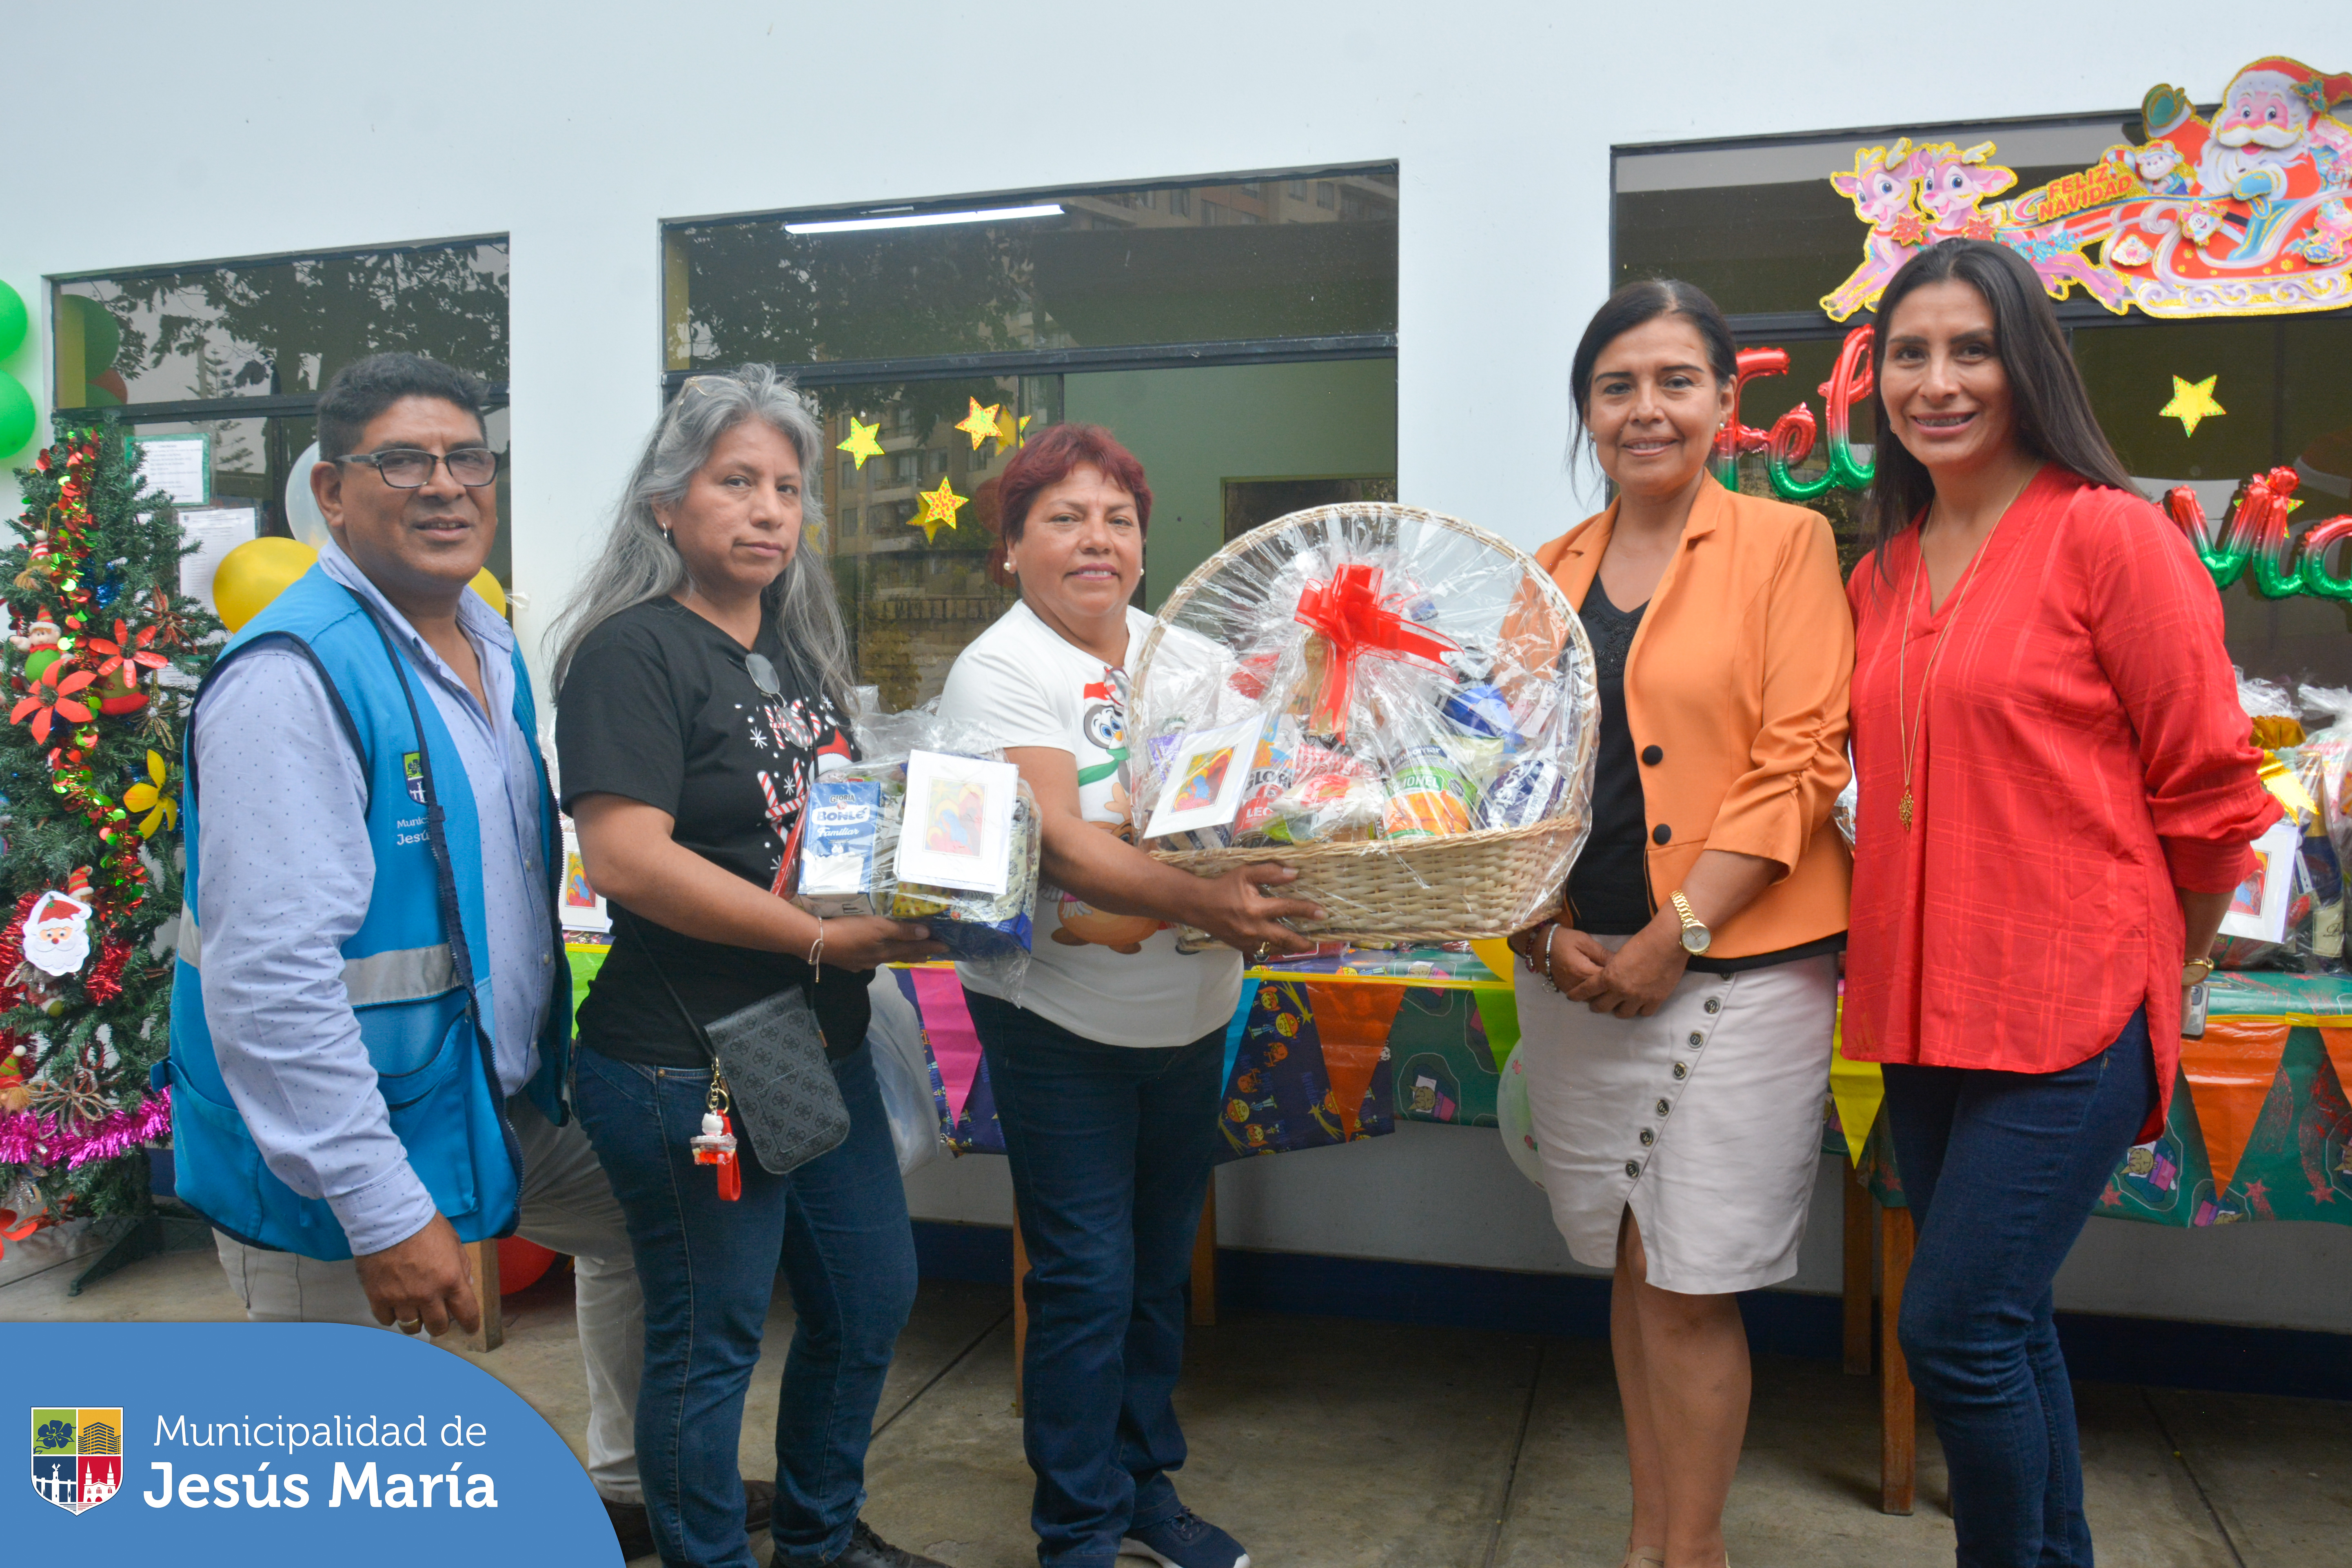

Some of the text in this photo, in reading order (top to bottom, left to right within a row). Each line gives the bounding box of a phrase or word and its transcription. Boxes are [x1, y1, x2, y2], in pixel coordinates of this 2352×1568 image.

[2049, 166, 2109, 199] FELIZ
[2040, 175, 2133, 220] NAVIDAD
[830, 794, 855, 803] GLORIA
[817, 827, 859, 837] Familiar
